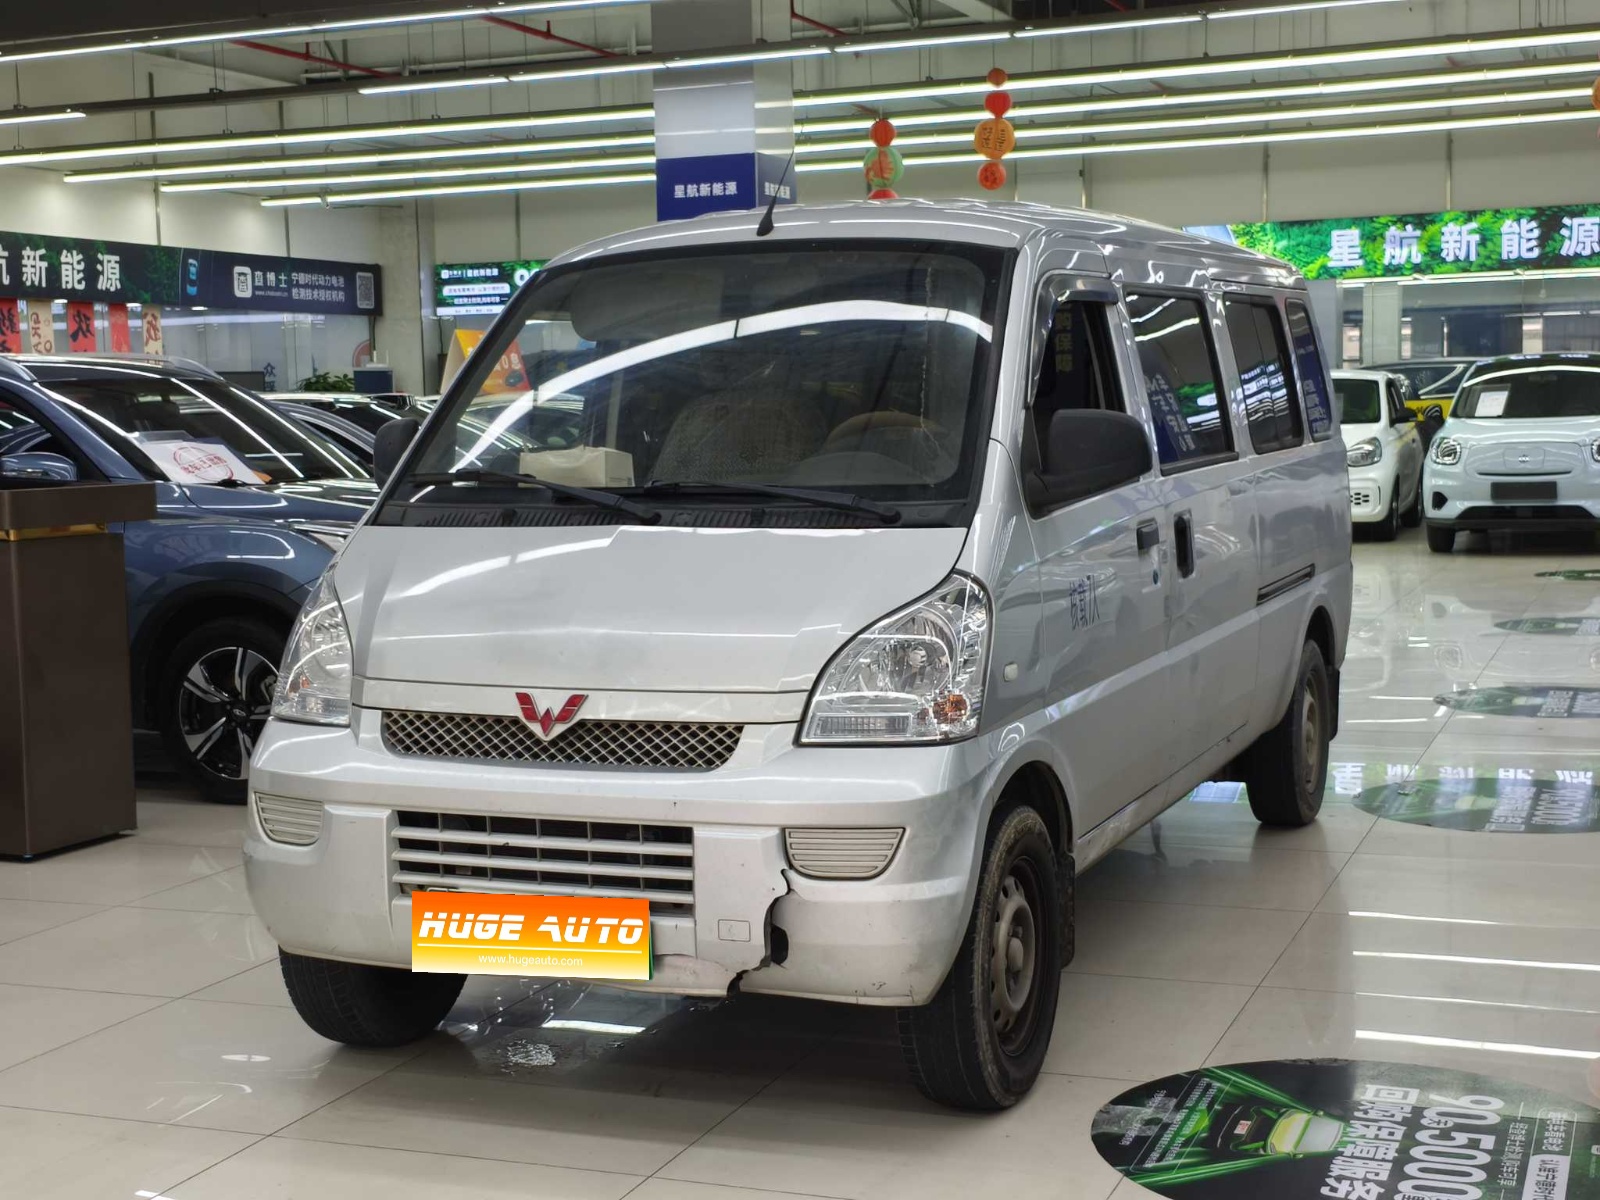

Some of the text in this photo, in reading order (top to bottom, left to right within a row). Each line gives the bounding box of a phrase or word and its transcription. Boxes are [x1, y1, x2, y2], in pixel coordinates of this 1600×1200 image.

[674, 181, 738, 198] 星航新能源
[1327, 216, 1600, 267] 星航新能源
[254, 271, 288, 288] 查博士
[291, 272, 345, 287] 宁德时代动力电池
[292, 288, 345, 303] 检测技术授权机构
[1320, 1084, 1420, 1200] 回购保障服务
